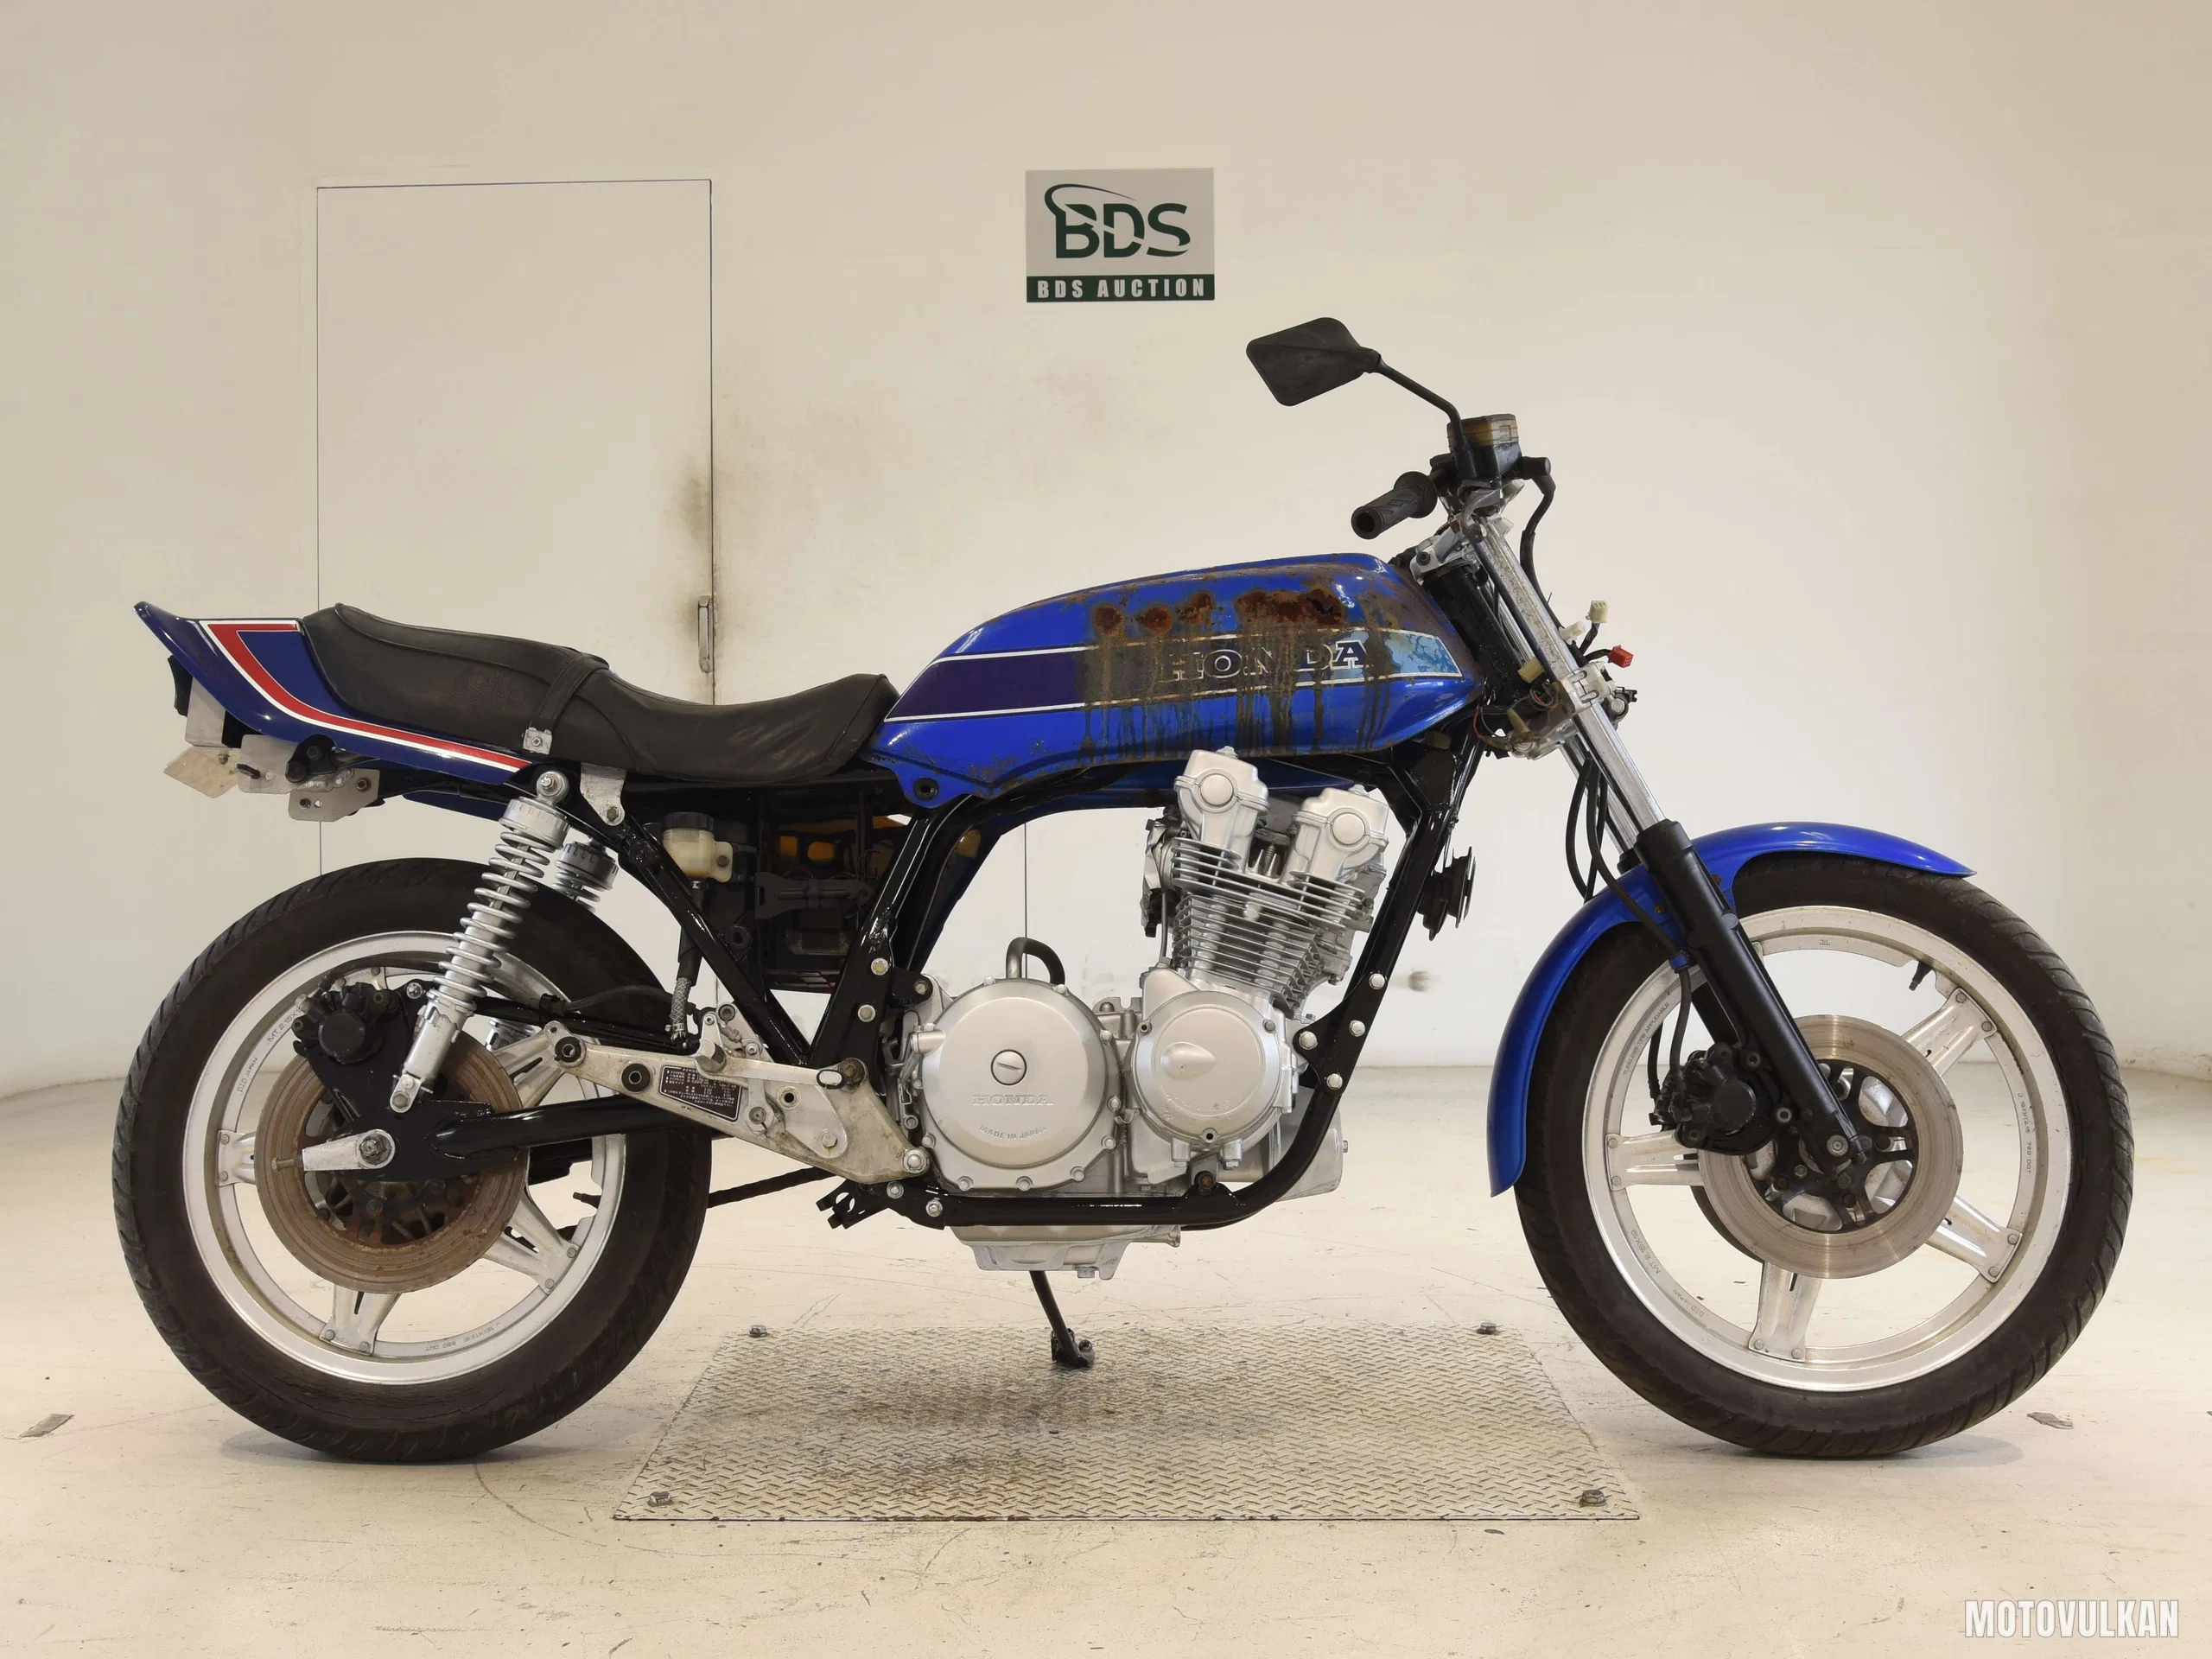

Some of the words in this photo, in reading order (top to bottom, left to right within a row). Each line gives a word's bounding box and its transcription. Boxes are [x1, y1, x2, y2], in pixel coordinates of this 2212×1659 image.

[1044, 183, 1191, 258] BDS
[1038, 280, 1083, 298] BDS
[1097, 278, 1205, 297] AUCTION
[278, 1007, 302, 1031] 2.15X1
[245, 1057, 258, 1077] JAPAN
[973, 1094, 1054, 1106] HONDA
[979, 1125, 1005, 1139] MADE
[1020, 1126, 1047, 1139] JAPAN
